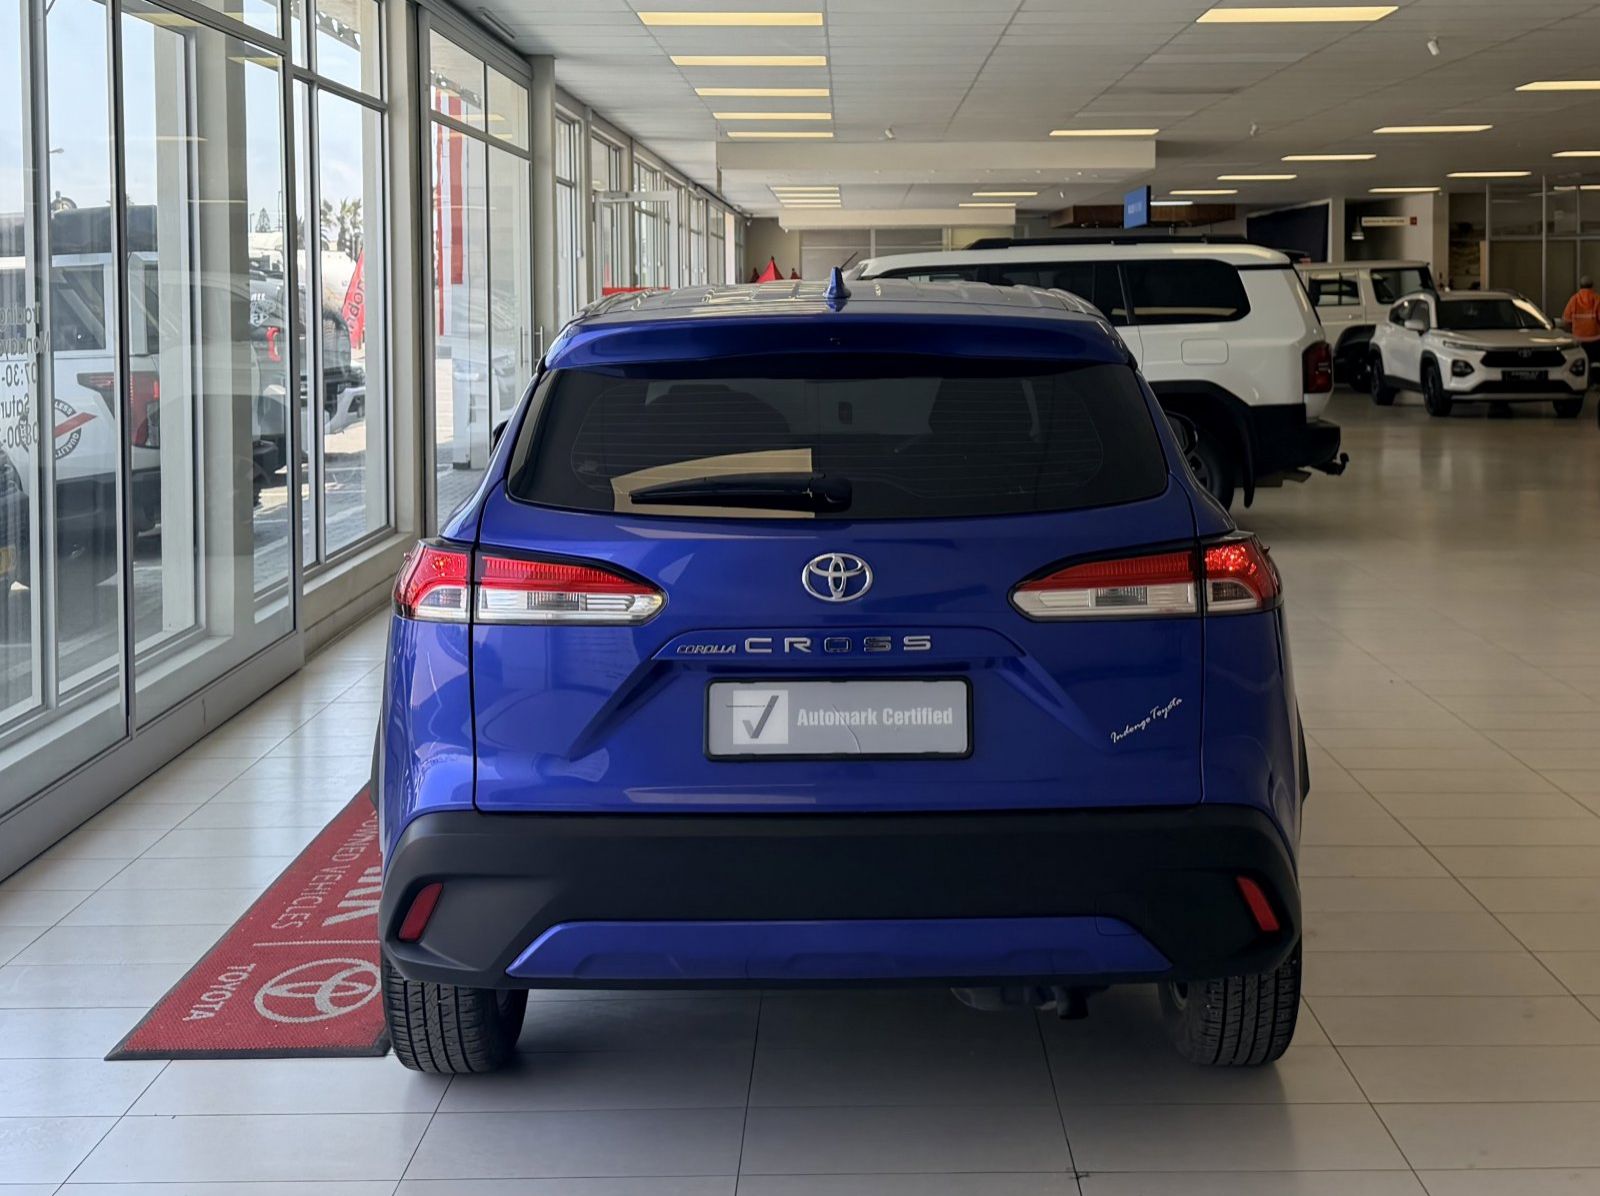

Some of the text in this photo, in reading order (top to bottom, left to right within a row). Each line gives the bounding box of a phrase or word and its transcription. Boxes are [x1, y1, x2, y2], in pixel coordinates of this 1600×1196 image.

[676, 635, 932, 654] COROLLA CROSS
[797, 707, 953, 727] Automark Certified
[1150, 697, 1183, 719] Toyota
[271, 865, 350, 930] VEHICLES
[182, 963, 256, 1021] TOYOTA
